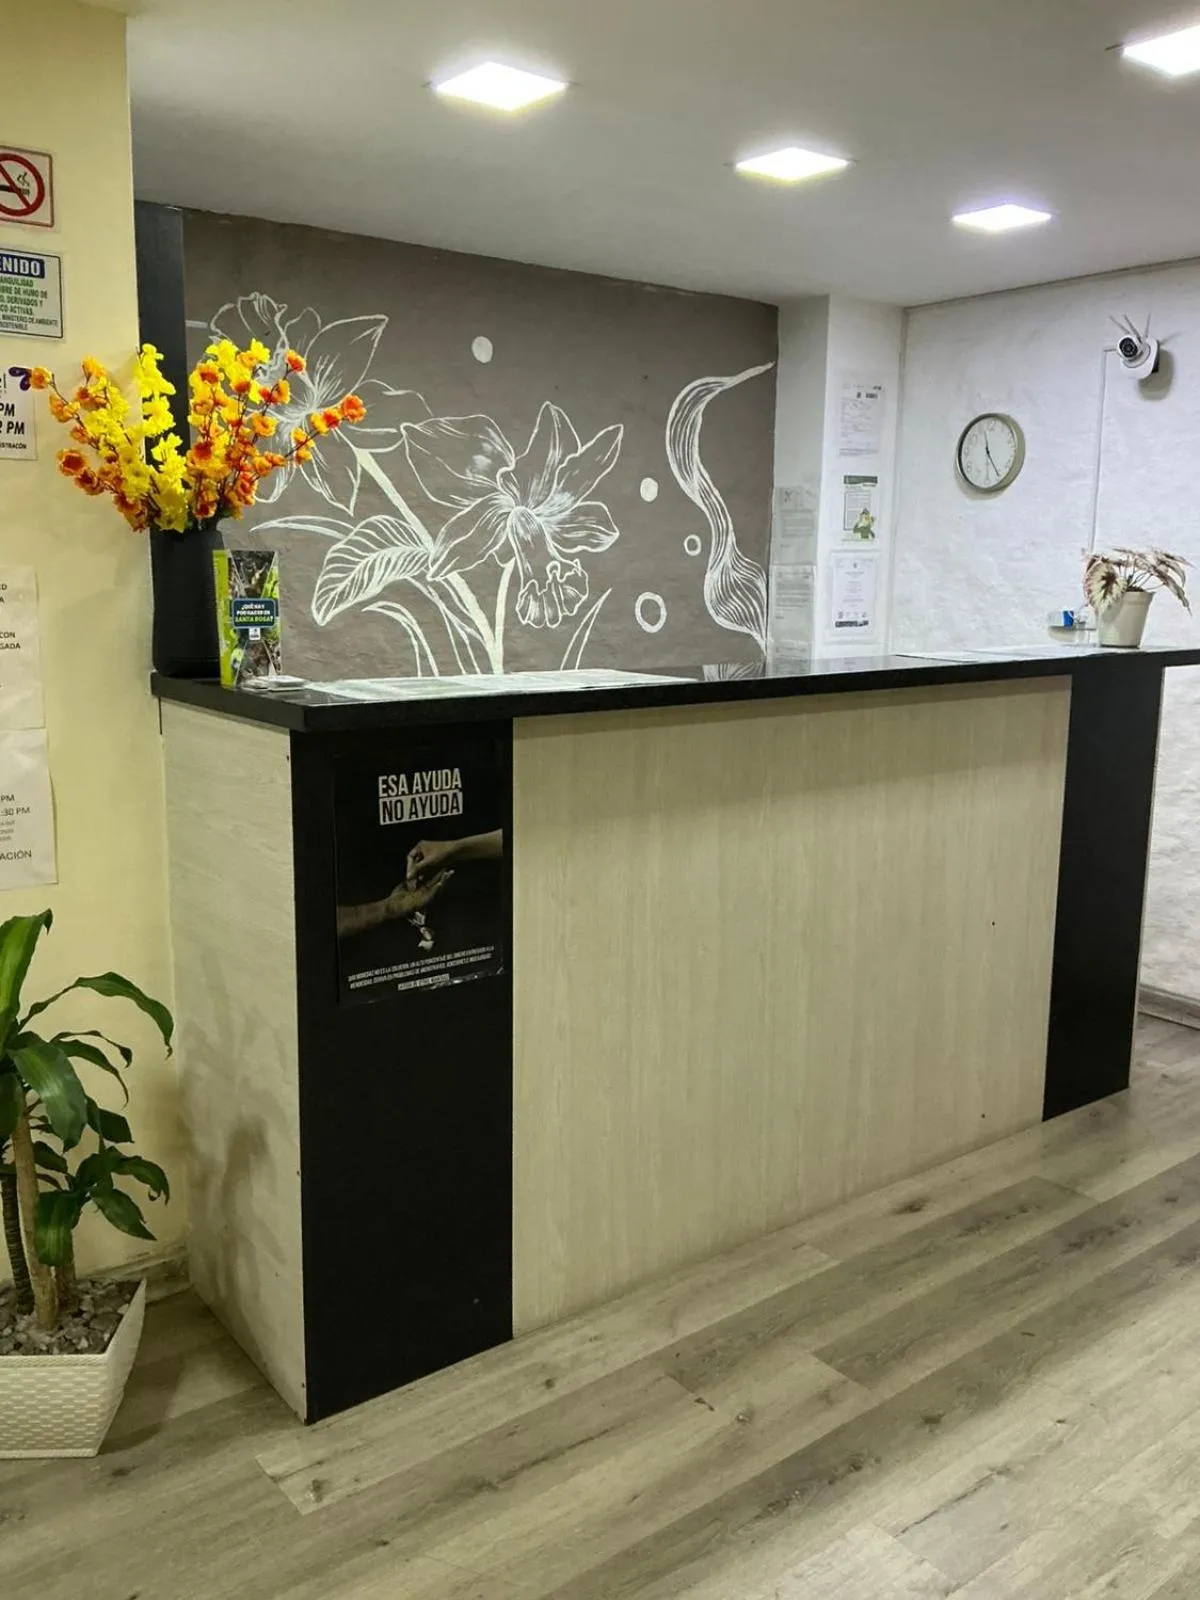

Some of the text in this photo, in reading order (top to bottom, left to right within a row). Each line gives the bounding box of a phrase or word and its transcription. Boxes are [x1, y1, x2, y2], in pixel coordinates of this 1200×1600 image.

[0, 256, 40, 275] NIDO
[6, 421, 25, 435] PM
[378, 767, 462, 797] ESA AYUDA
[382, 791, 460, 823] NO AYUDA
